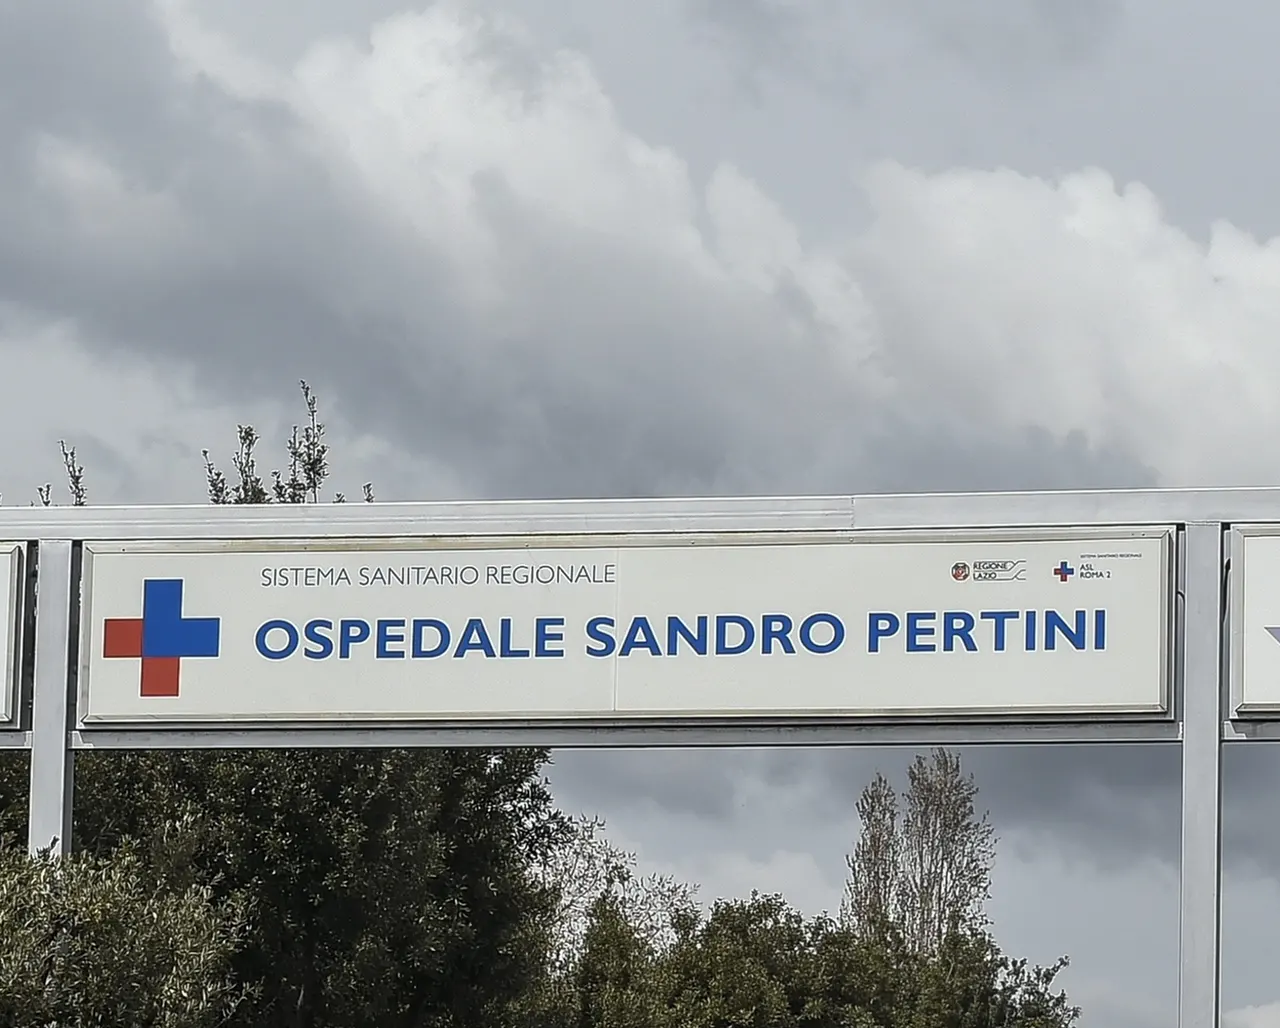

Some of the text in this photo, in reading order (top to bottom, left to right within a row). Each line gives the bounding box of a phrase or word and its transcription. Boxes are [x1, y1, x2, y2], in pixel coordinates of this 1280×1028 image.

[973, 562, 1008, 570] REGIONE
[1080, 563, 1094, 571] ASL
[261, 564, 615, 587] SISTEMA SANITARIO REGIONALE
[973, 572, 997, 580] LAZIO
[1080, 571, 1104, 579] ROMA
[255, 609, 1106, 660] OSPEDALE SANDRO PERTINI
